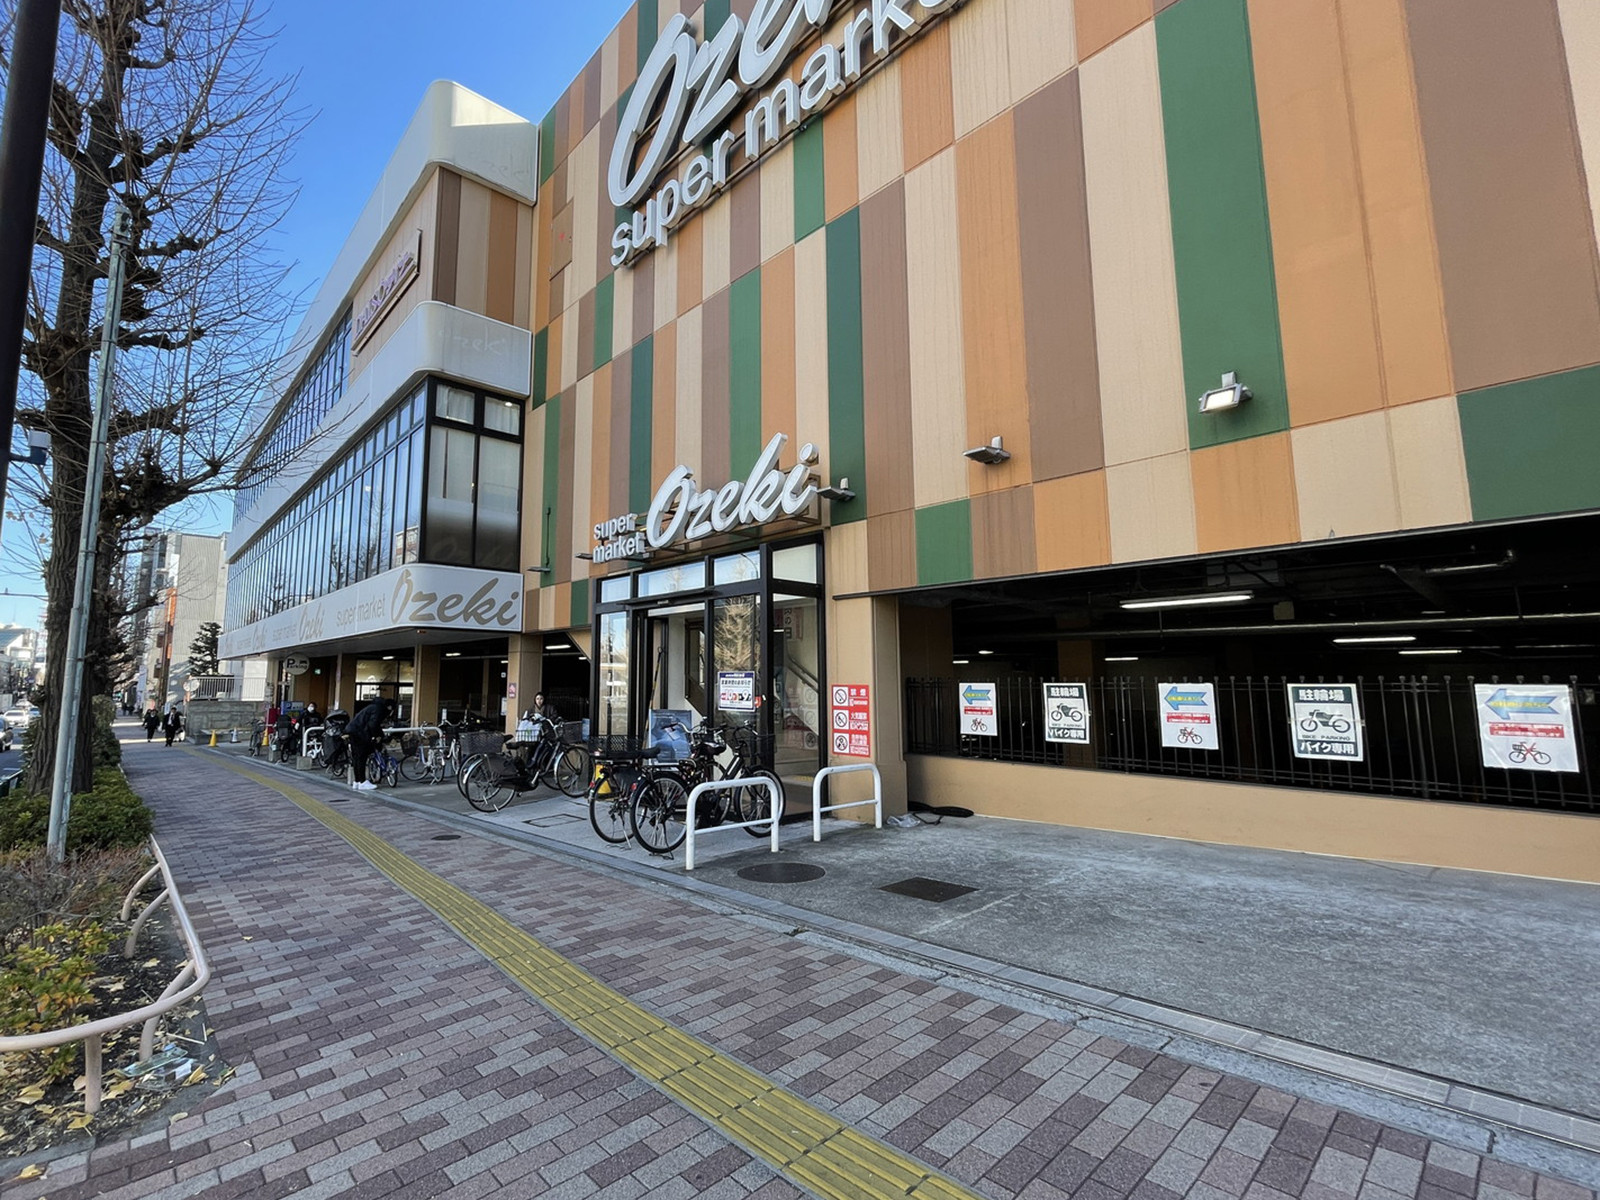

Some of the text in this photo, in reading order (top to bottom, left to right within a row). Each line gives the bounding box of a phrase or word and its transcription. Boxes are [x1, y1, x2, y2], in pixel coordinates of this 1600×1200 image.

[607, 0, 833, 207] Oze
[610, 129, 735, 267] super
[646, 432, 819, 548] Ozeki
[593, 513, 637, 540] super
[592, 531, 646, 563] market
[335, 568, 520, 627] super market Ozeki
[286, 658, 307, 669] Parking
[1299, 689, 1344, 701] 駐輪場
[1301, 742, 1354, 754] バイク専用
